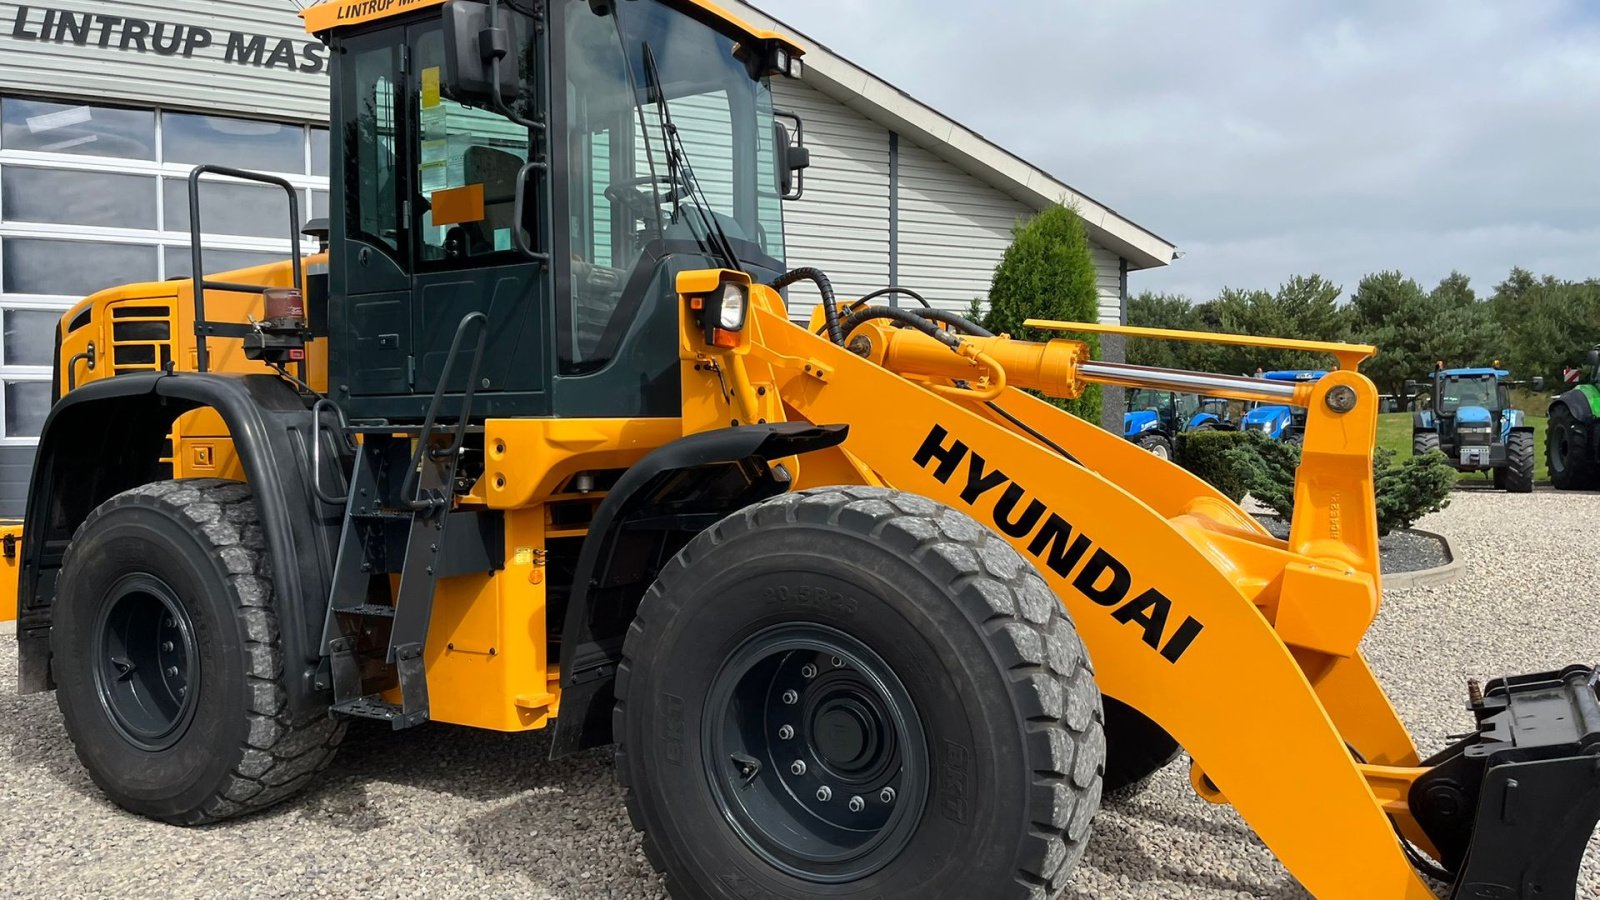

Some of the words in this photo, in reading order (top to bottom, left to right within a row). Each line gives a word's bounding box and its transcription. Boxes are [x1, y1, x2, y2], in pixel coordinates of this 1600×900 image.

[12, 5, 212, 58] LINTRUP
[224, 30, 330, 75] MAS
[337, 0, 394, 19] LINTRUP
[912, 423, 1204, 664] HYUNDAI
